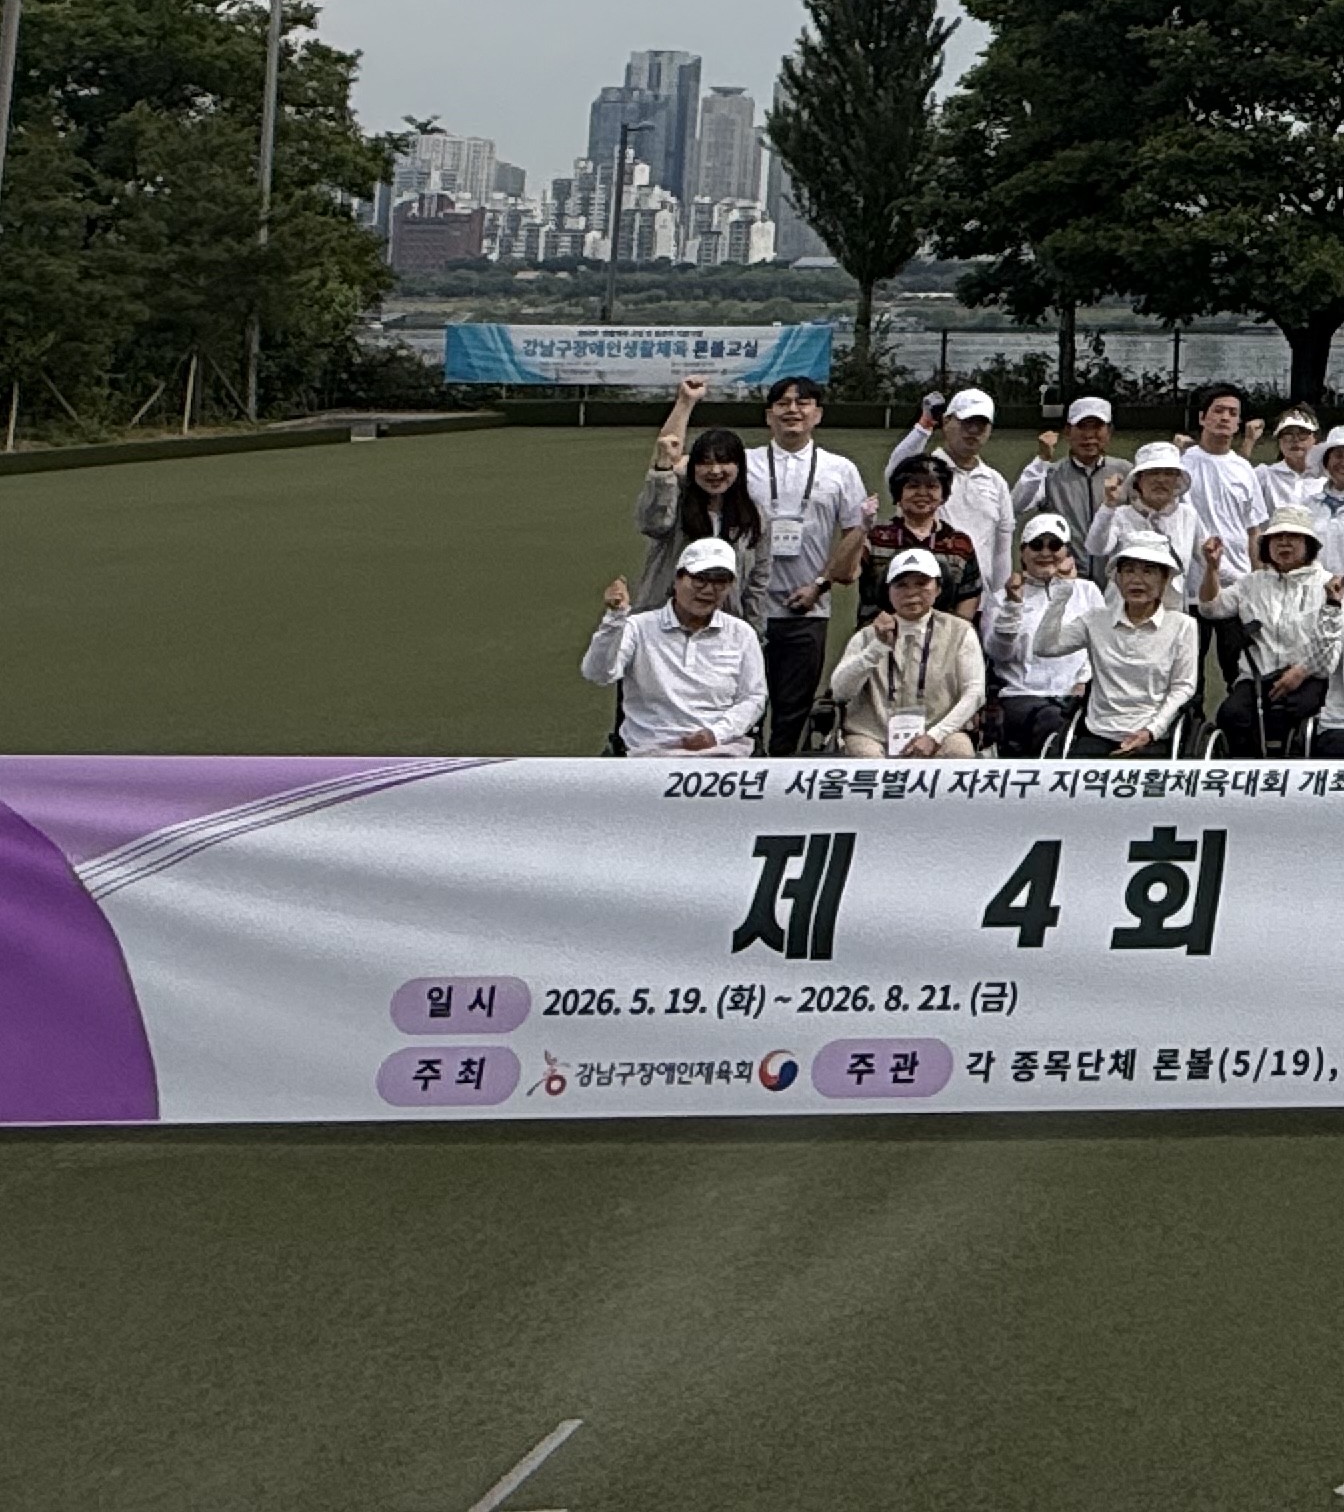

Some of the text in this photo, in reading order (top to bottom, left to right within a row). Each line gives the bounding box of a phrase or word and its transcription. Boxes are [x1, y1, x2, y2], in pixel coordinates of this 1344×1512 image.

[663, 770, 768, 800] 2026년
[785, 769, 941, 801] 서울특별시
[947, 769, 1039, 799] 자치구
[1049, 769, 1289, 798] 지역생활체육대회
[731, 833, 857, 960] 제
[981, 826, 1227, 955] 4회
[543, 989, 621, 1015] 2026.
[629, 989, 655, 1015] 5.
[665, 988, 707, 1014] 19.
[717, 984, 765, 1019] (화)
[797, 985, 875, 1012] 2026.
[885, 985, 909, 1011] 8.
[917, 985, 960, 1011] 21.
[971, 981, 1017, 1016] (금)
[575, 1061, 753, 1087] 강남구장애인체육회
[967, 1051, 995, 1083] 각
[1011, 1049, 1136, 1082] 종목단체
[1153, 1047, 1337, 1083] 론볼(5/19),
